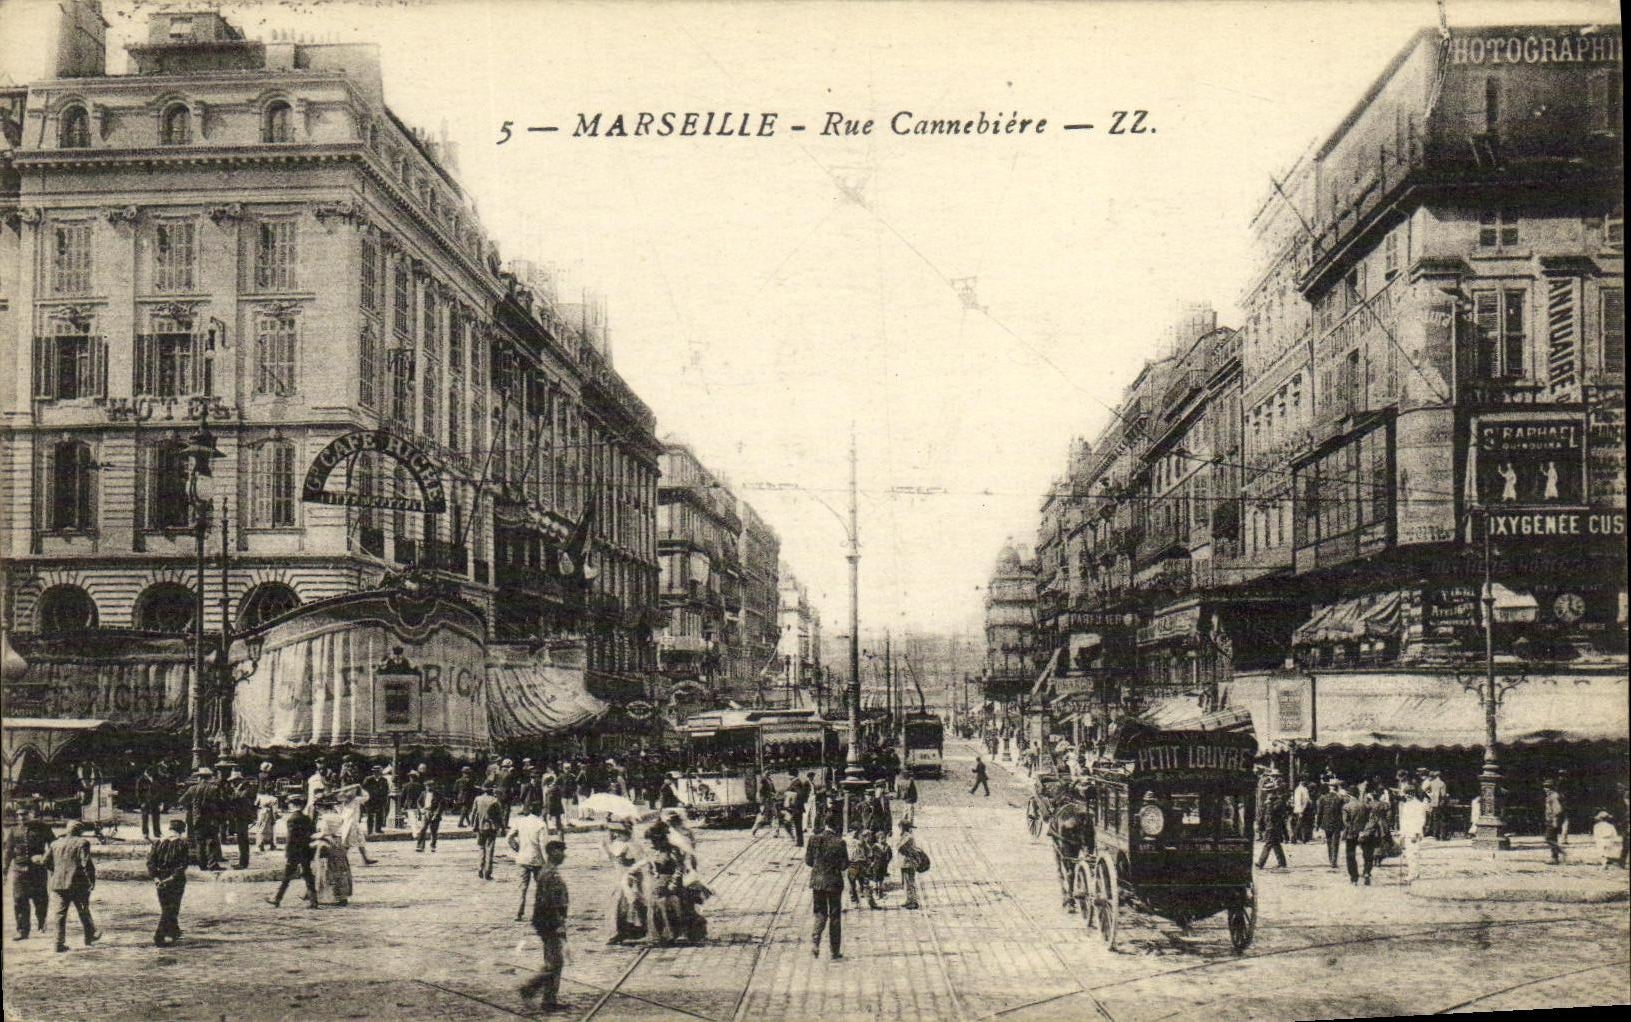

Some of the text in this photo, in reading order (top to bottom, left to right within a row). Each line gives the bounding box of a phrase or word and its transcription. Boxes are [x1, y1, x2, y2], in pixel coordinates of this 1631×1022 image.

[1450, 36, 1623, 64] HOTOGRAPHI
[1549, 279, 1575, 395] ANNUAIRE
[1588, 515, 1626, 535] CUS
[1138, 744, 1250, 773] PETIT LOUVRE
